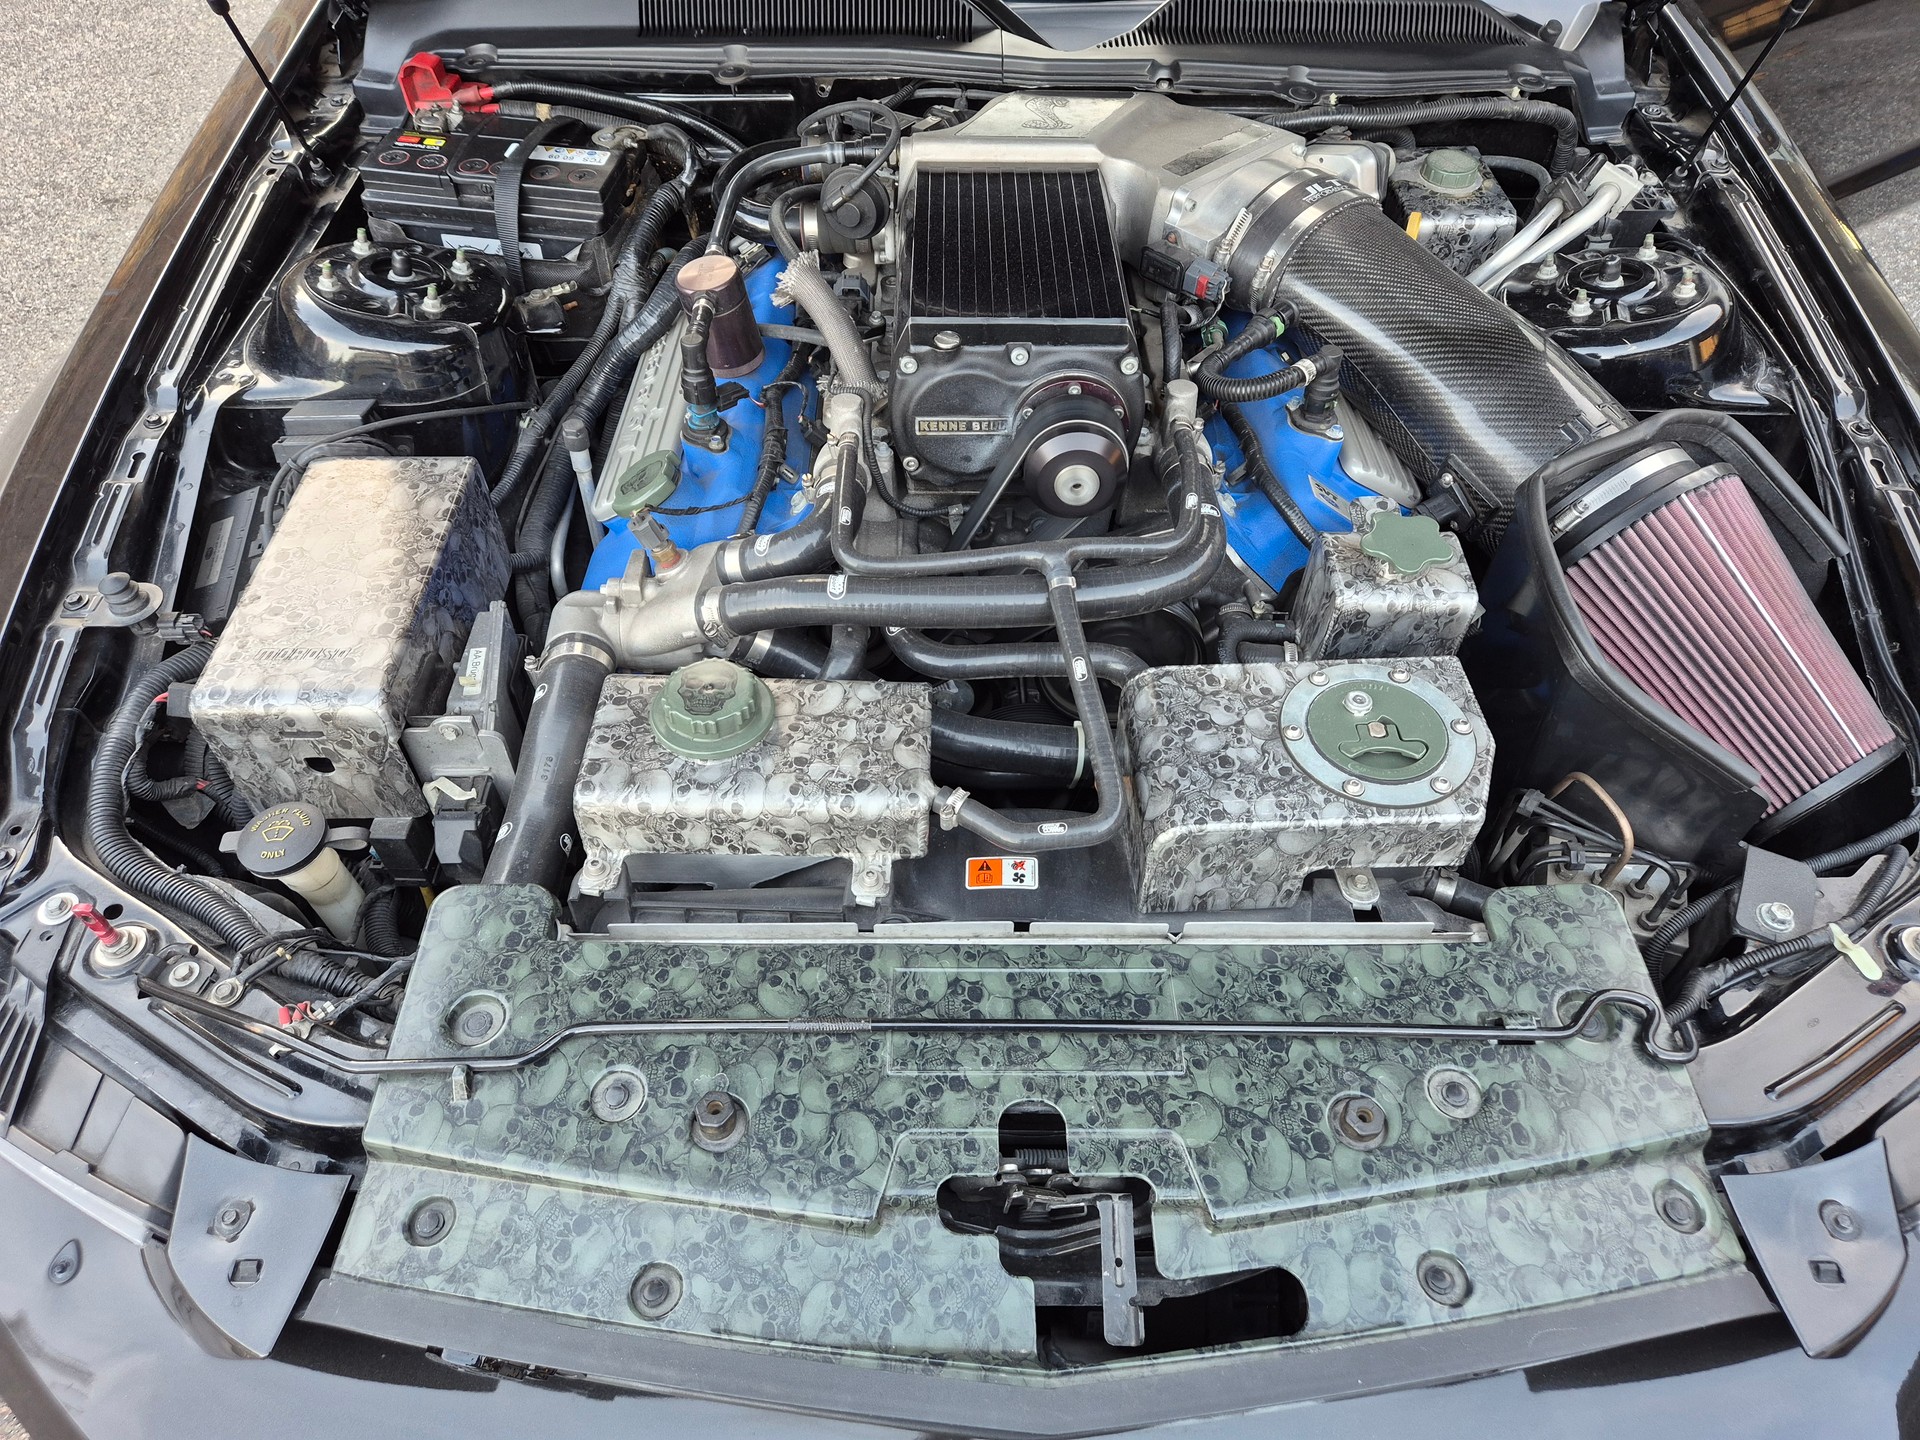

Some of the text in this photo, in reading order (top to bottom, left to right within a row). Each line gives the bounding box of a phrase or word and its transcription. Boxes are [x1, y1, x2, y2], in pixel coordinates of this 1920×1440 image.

[1302, 179, 1342, 201] JLT
[920, 420, 1007, 432] KENNE BELL
[250, 808, 312, 832] WASHER FLUID
[260, 848, 286, 859] ONLY
